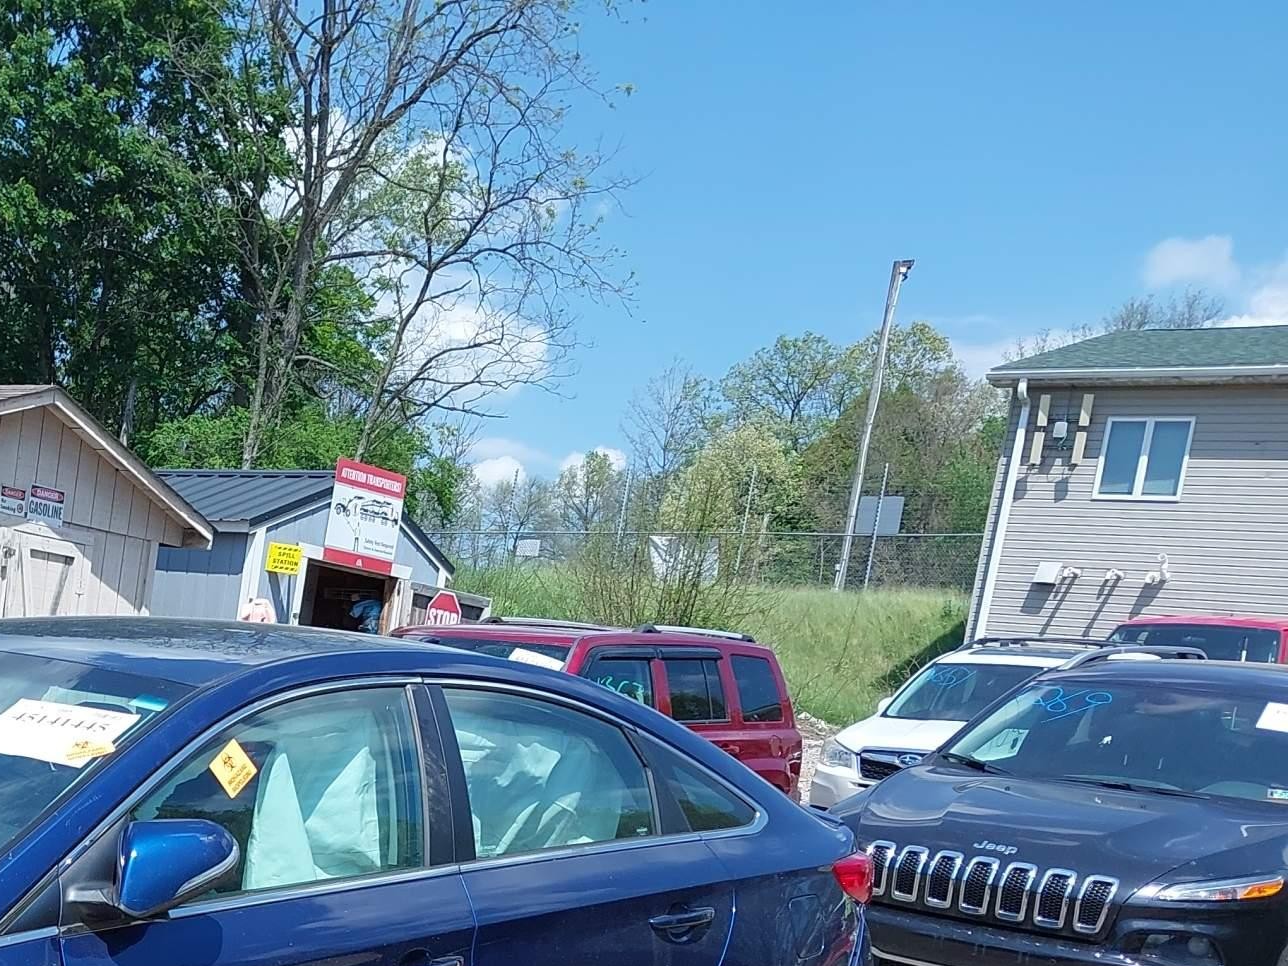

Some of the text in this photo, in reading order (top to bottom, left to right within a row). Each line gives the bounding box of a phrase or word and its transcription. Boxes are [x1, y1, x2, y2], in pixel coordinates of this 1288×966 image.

[36, 488, 60, 500] DANGER
[28, 500, 63, 520] GASOLINE
[278, 551, 295, 559] SPILL
[272, 558, 299, 567] STATION
[427, 607, 458, 625] STOP
[973, 840, 1019, 855] Jeep
